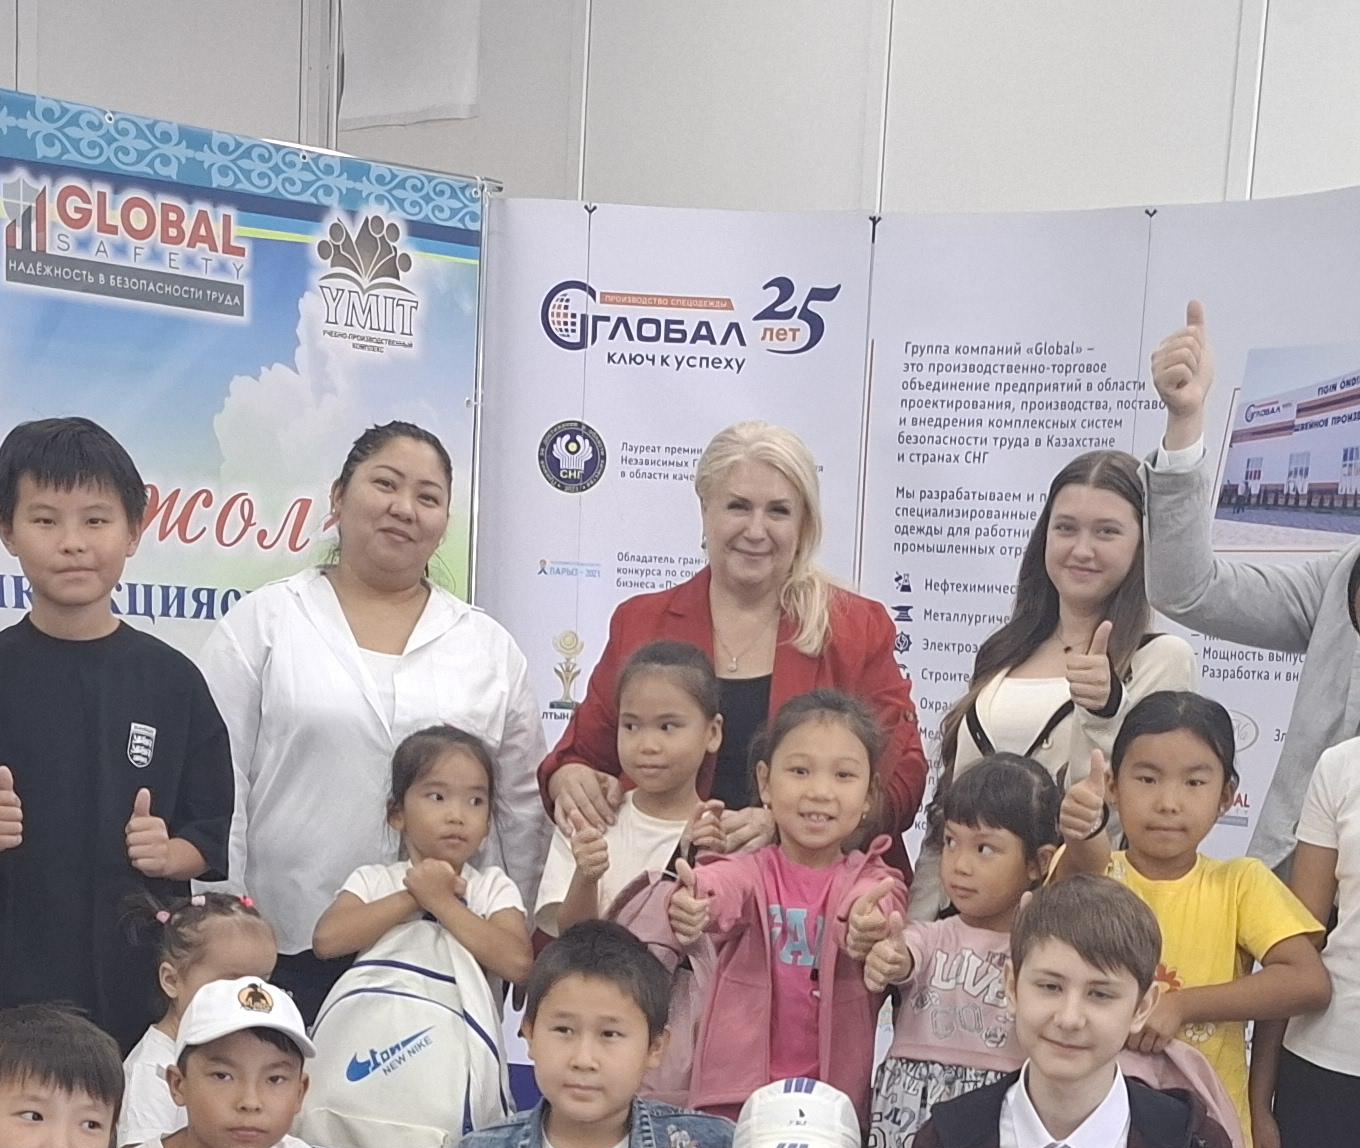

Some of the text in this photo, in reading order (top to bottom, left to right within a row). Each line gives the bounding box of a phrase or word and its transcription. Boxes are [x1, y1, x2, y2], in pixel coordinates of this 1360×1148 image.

[56, 184, 246, 257] GLOBAL
[57, 233, 244, 280] SAFETY
[9, 258, 241, 307] НАДЁЖНОСТЬ В БЕЗОПАСНОСТИ ТРУДА
[605, 293, 728, 309] ПРОИЗВОДСТВО СПЕЦОДЕЖДЫ
[752, 276, 841, 355] 25
[761, 327, 800, 342] лет
[904, 341, 950, 356] Группа
[955, 342, 1021, 355] компаний
[1026, 341, 1083, 355] «Global»
[903, 361, 1107, 376] это производственно-торговое
[901, 378, 1146, 395] объединение предприятий в области
[900, 398, 1166, 413] проектирования, производства, поставо
[899, 416, 1123, 431] и внедрения комплексных систем
[1294, 416, 1329, 432] ШВЕЙНОЕ
[898, 431, 1115, 449] безопасности труда в Казахстане
[621, 442, 661, 457] Лауреат
[620, 455, 689, 468] Независимых
[897, 451, 989, 466] и странах СНГ
[560, 469, 584, 479] СНГ
[620, 469, 696, 481] в области каче
[896, 486, 915, 499] Мы
[919, 487, 1021, 503] разрабатываем
[1026, 493, 1034, 502] и
[895, 505, 1037, 521] специализированные
[894, 523, 1031, 540] одежды для работни
[893, 541, 995, 557] промышленных
[617, 551, 707, 566] Обладатель гран-
[617, 567, 662, 579] конкурса
[665, 570, 676, 580] по
[616, 578, 656, 589] бизнеса
[925, 578, 1016, 597] Нефтехимичес
[923, 608, 1010, 627] Металлургиче
[922, 638, 978, 655] Электроэ
[1203, 647, 1305, 668] Мощность выпус
[921, 667, 970, 684] Строите
[1202, 665, 1269, 682] Разработка
[1274, 671, 1281, 681] и
[542, 711, 569, 720] ЛТЫН
[383, 1035, 433, 1076] NEW NIKE
